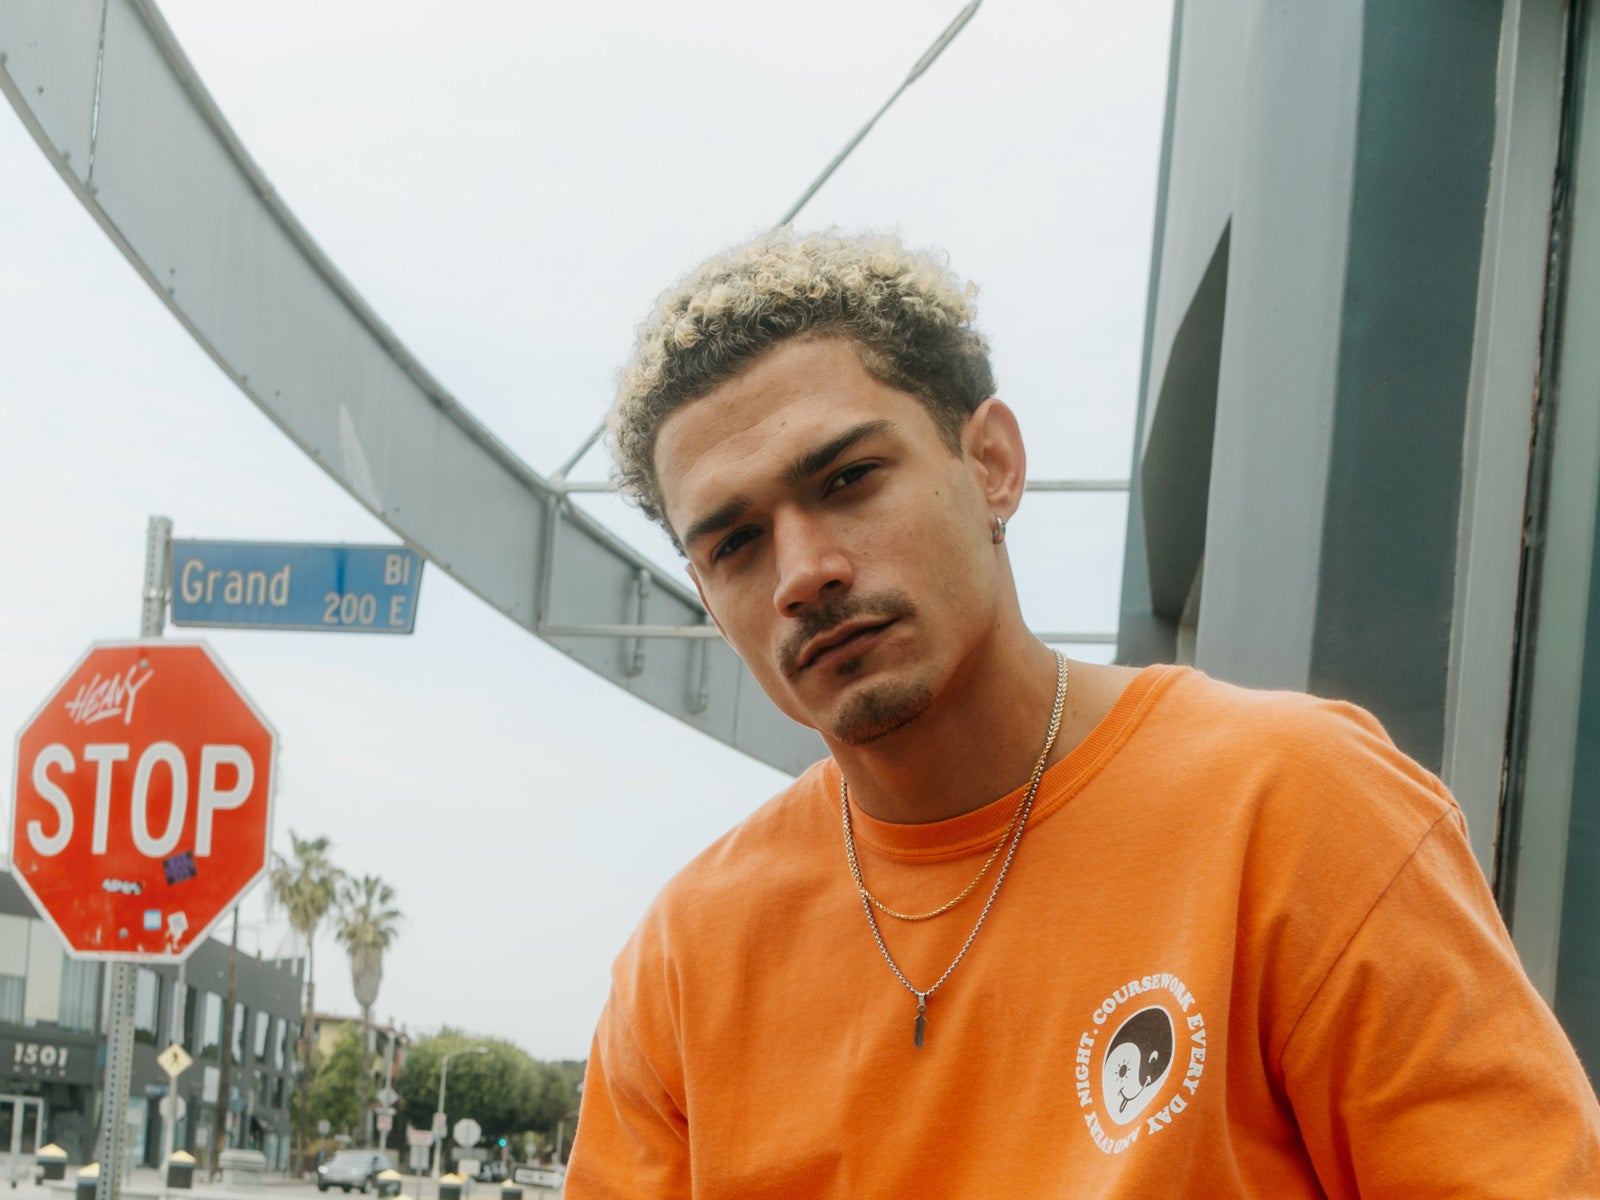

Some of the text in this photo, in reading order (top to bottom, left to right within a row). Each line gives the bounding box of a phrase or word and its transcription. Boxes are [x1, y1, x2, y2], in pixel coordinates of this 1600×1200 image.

[181, 559, 291, 607] Grand
[323, 593, 406, 626] 200 E
[65, 665, 154, 725] HEAVY
[27, 741, 255, 857] STOP
[1093, 973, 1196, 1025] COURSEWORK
[14, 1042, 68, 1067] 1501
[1183, 1013, 1207, 1095] EVERY
[1084, 1111, 1114, 1155] EVERY
[1147, 1094, 1188, 1135] DAY
[1113, 1126, 1140, 1155] AND
